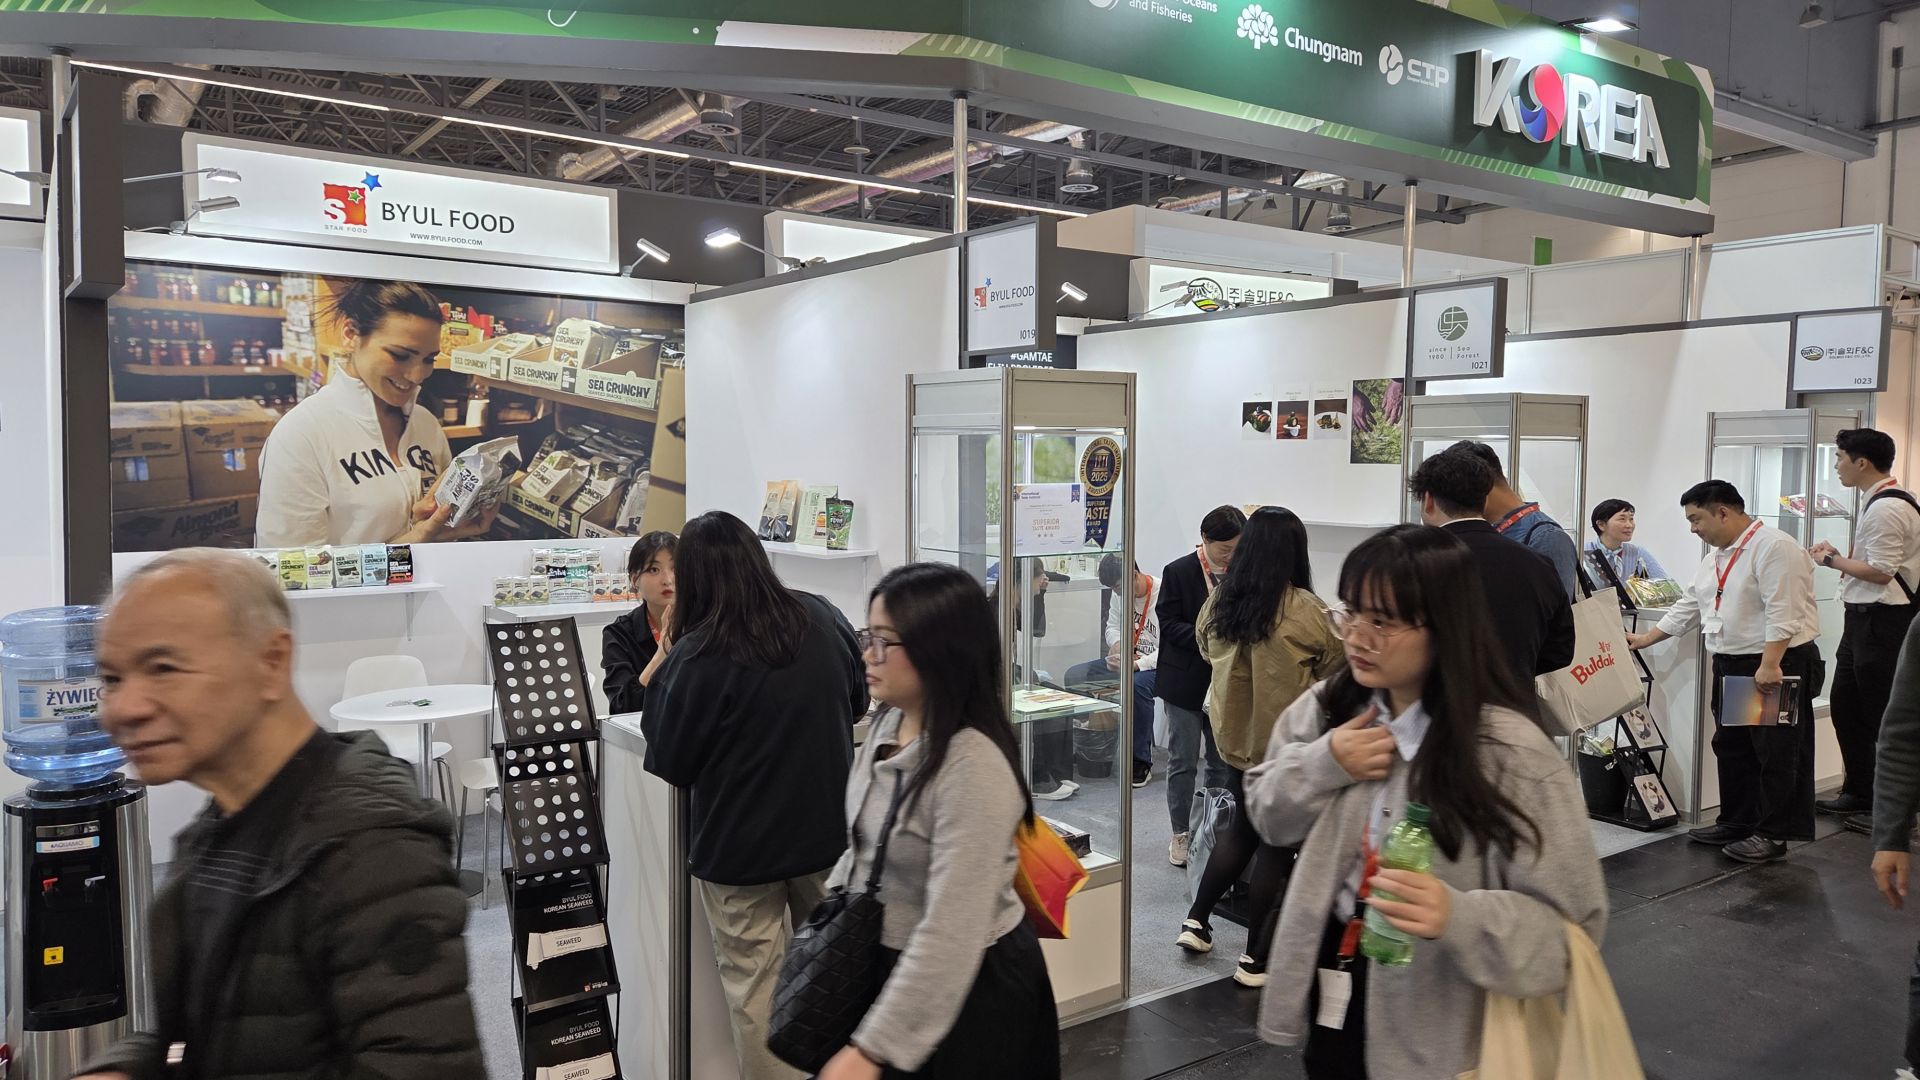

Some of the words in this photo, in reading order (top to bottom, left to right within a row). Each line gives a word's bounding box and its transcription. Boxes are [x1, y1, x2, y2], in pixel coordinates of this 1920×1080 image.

[1129, 0, 1148, 11] and
[1151, 4, 1193, 23] Fisheries
[1284, 27, 1363, 67] Chungnam
[1407, 58, 1450, 88] CTP
[1473, 48, 1670, 169] KOREA
[381, 201, 443, 227] BYUL
[450, 209, 515, 234] FOOD
[324, 224, 344, 232] STAR
[347, 226, 368, 234] FOOD
[410, 232, 483, 246] WWW.BYULFOOD.COM
[990, 289, 1010, 302] BYUL
[1011, 285, 1035, 299] FOOD
[557, 326, 570, 335] SEA
[513, 366, 526, 377] SEA
[526, 368, 559, 382] CRUNCHY
[588, 378, 605, 391] SEA
[605, 381, 651, 399] CRUNCHY
[1091, 472, 1109, 482] 2025
[1085, 507, 1110, 520] ASTE
[1569, 653, 1615, 686] Buldak
[577, 892, 592, 900] FOOD
[543, 904, 567, 914] KOREAN
[567, 899, 594, 909] SEAWEED
[556, 936, 582, 948] SEAWEED
[584, 1020, 600, 1029] FOOD
[550, 1034, 574, 1046] KOREAN
[574, 1026, 601, 1039] SEAWEED
[564, 1068, 590, 1080] SEAWEED
